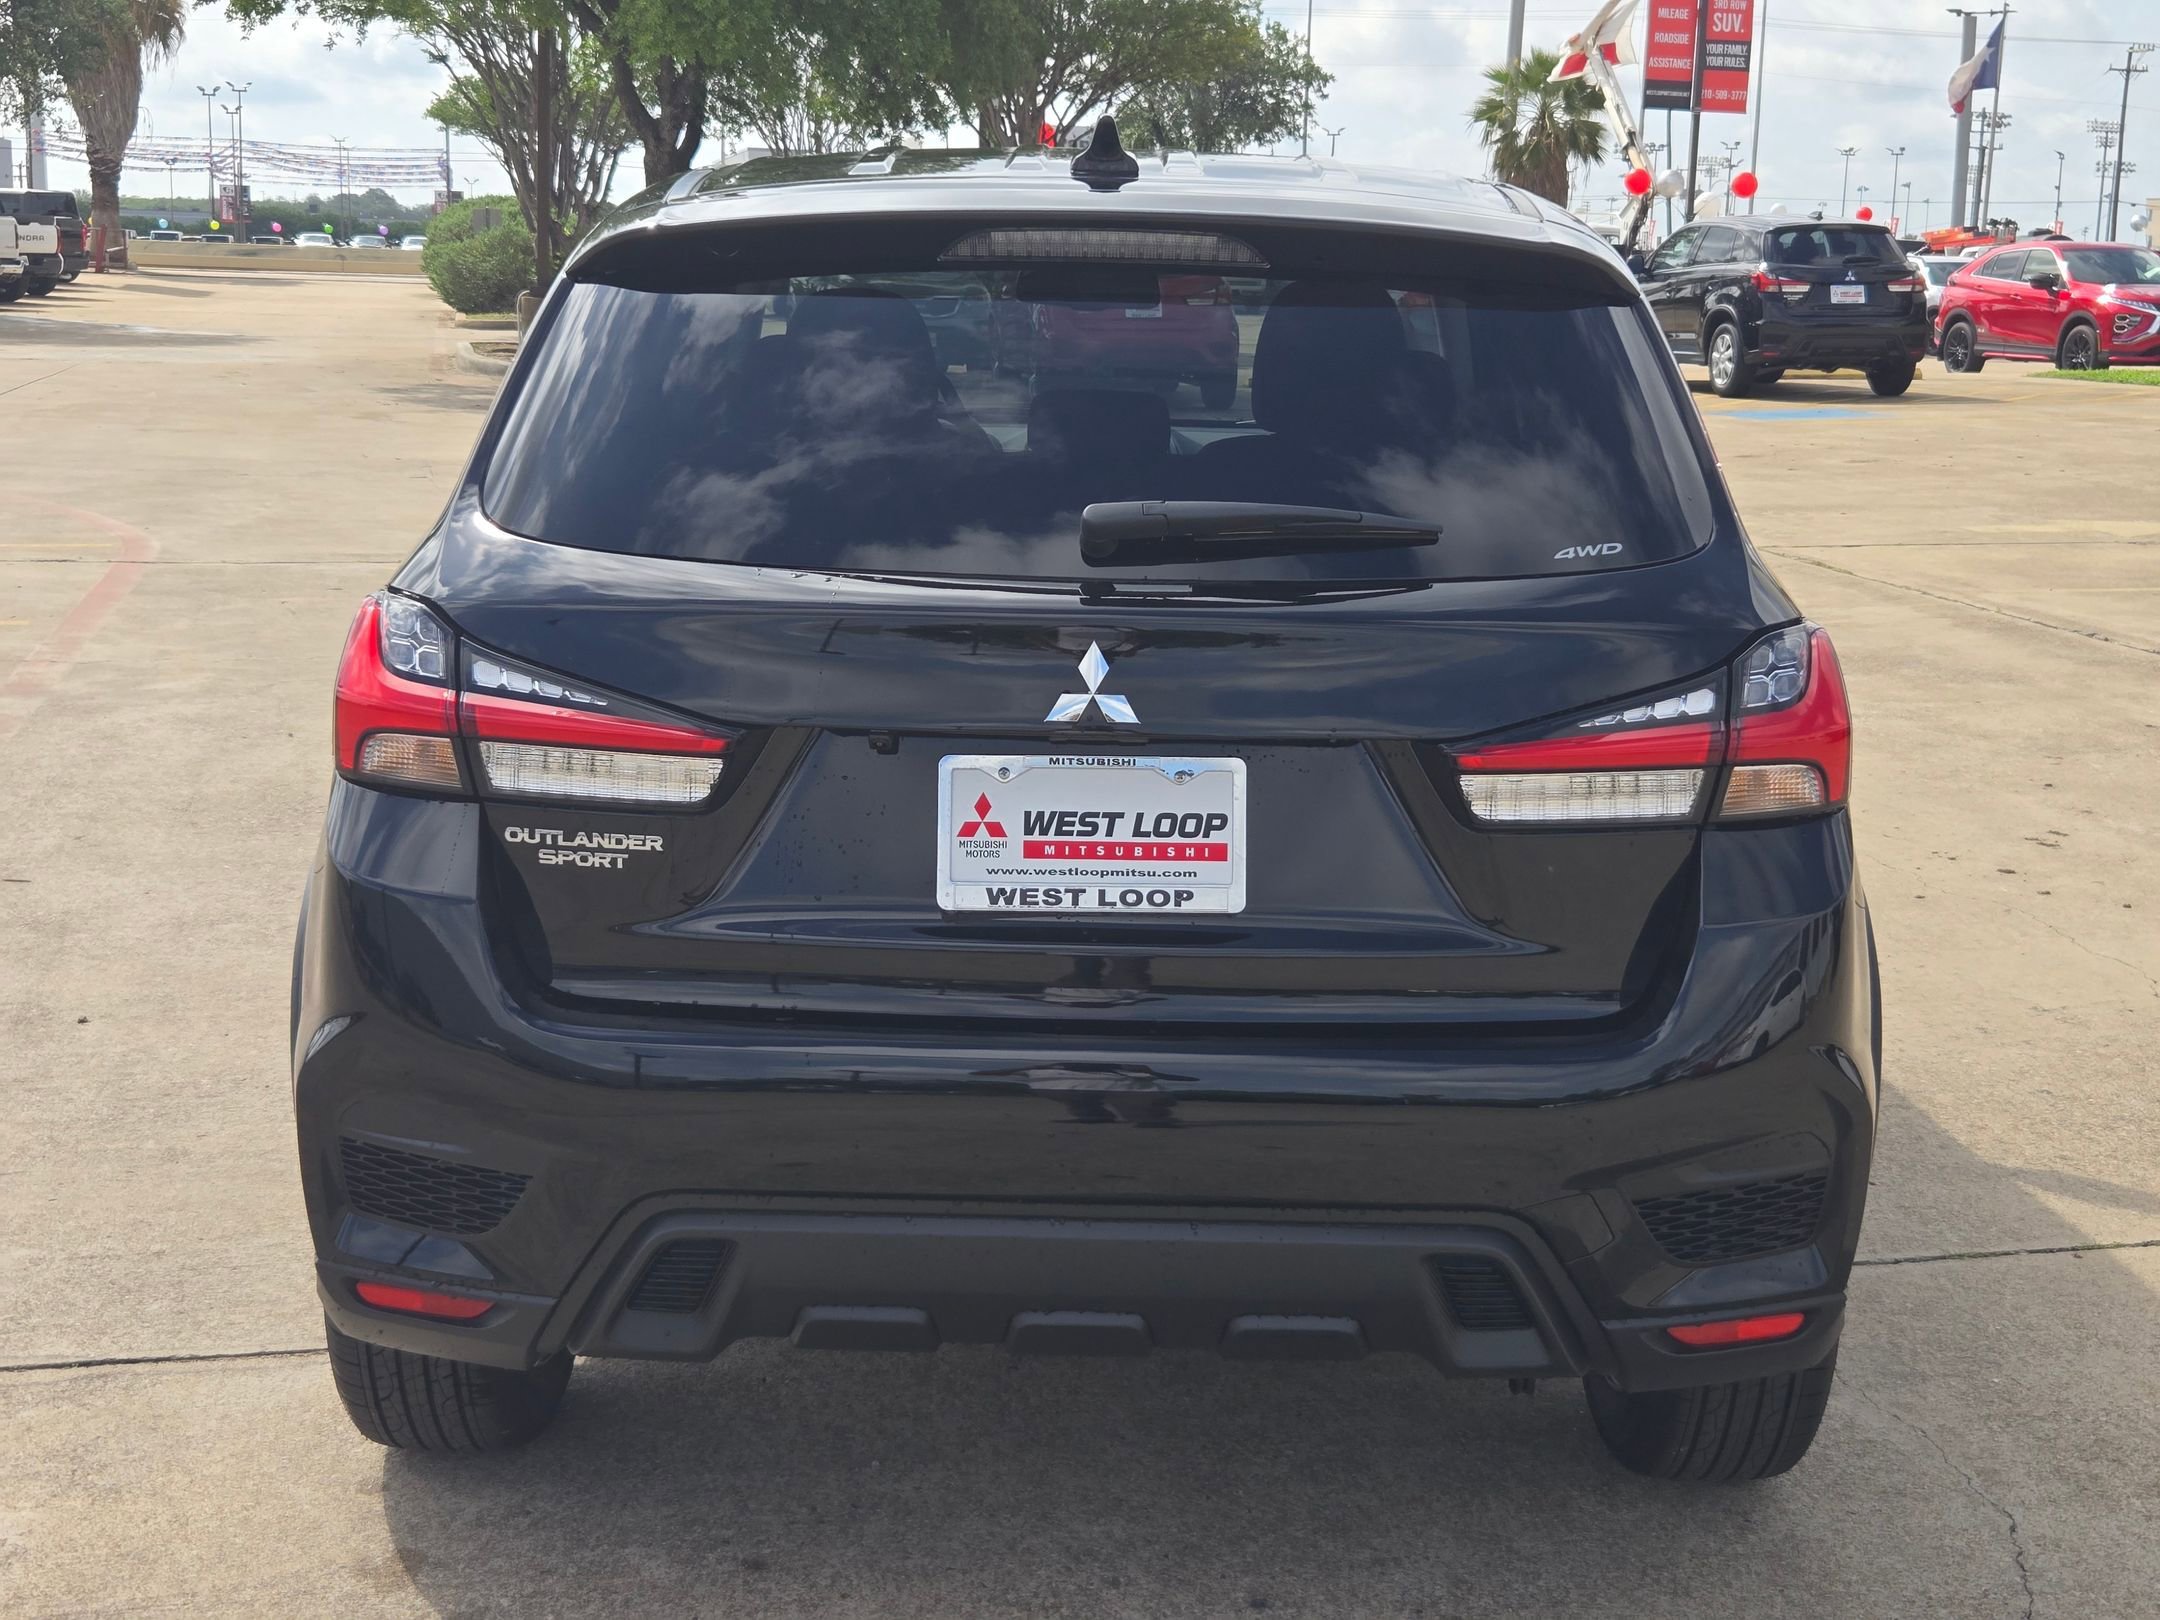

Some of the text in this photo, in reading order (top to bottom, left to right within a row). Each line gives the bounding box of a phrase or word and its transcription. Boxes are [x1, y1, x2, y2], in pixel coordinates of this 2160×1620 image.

[1658, 8, 1689, 20] MILEAGE
[1712, 13, 1744, 33] SUV.
[1654, 32, 1689, 45] ROADSIDE
[1705, 43, 1748, 56] YOUR FAMILY.
[1648, 57, 1692, 70] ASSISTANCE
[1705, 56, 1746, 68] YOUR RULES.
[1553, 542, 1623, 560] 4WD
[1048, 757, 1137, 767] MITSUBISHI
[1023, 810, 1229, 839] WEST LOOP
[504, 826, 664, 852] OUTLANDER
[958, 840, 1008, 849] MITSUBISHI
[965, 849, 1001, 859] MOTORS
[1044, 845, 1210, 858] MITSUBISHI
[538, 848, 629, 869] SPORT
[986, 867, 1198, 879] www.westloopmitsu.com
[986, 887, 1195, 908] WEST LOOP
